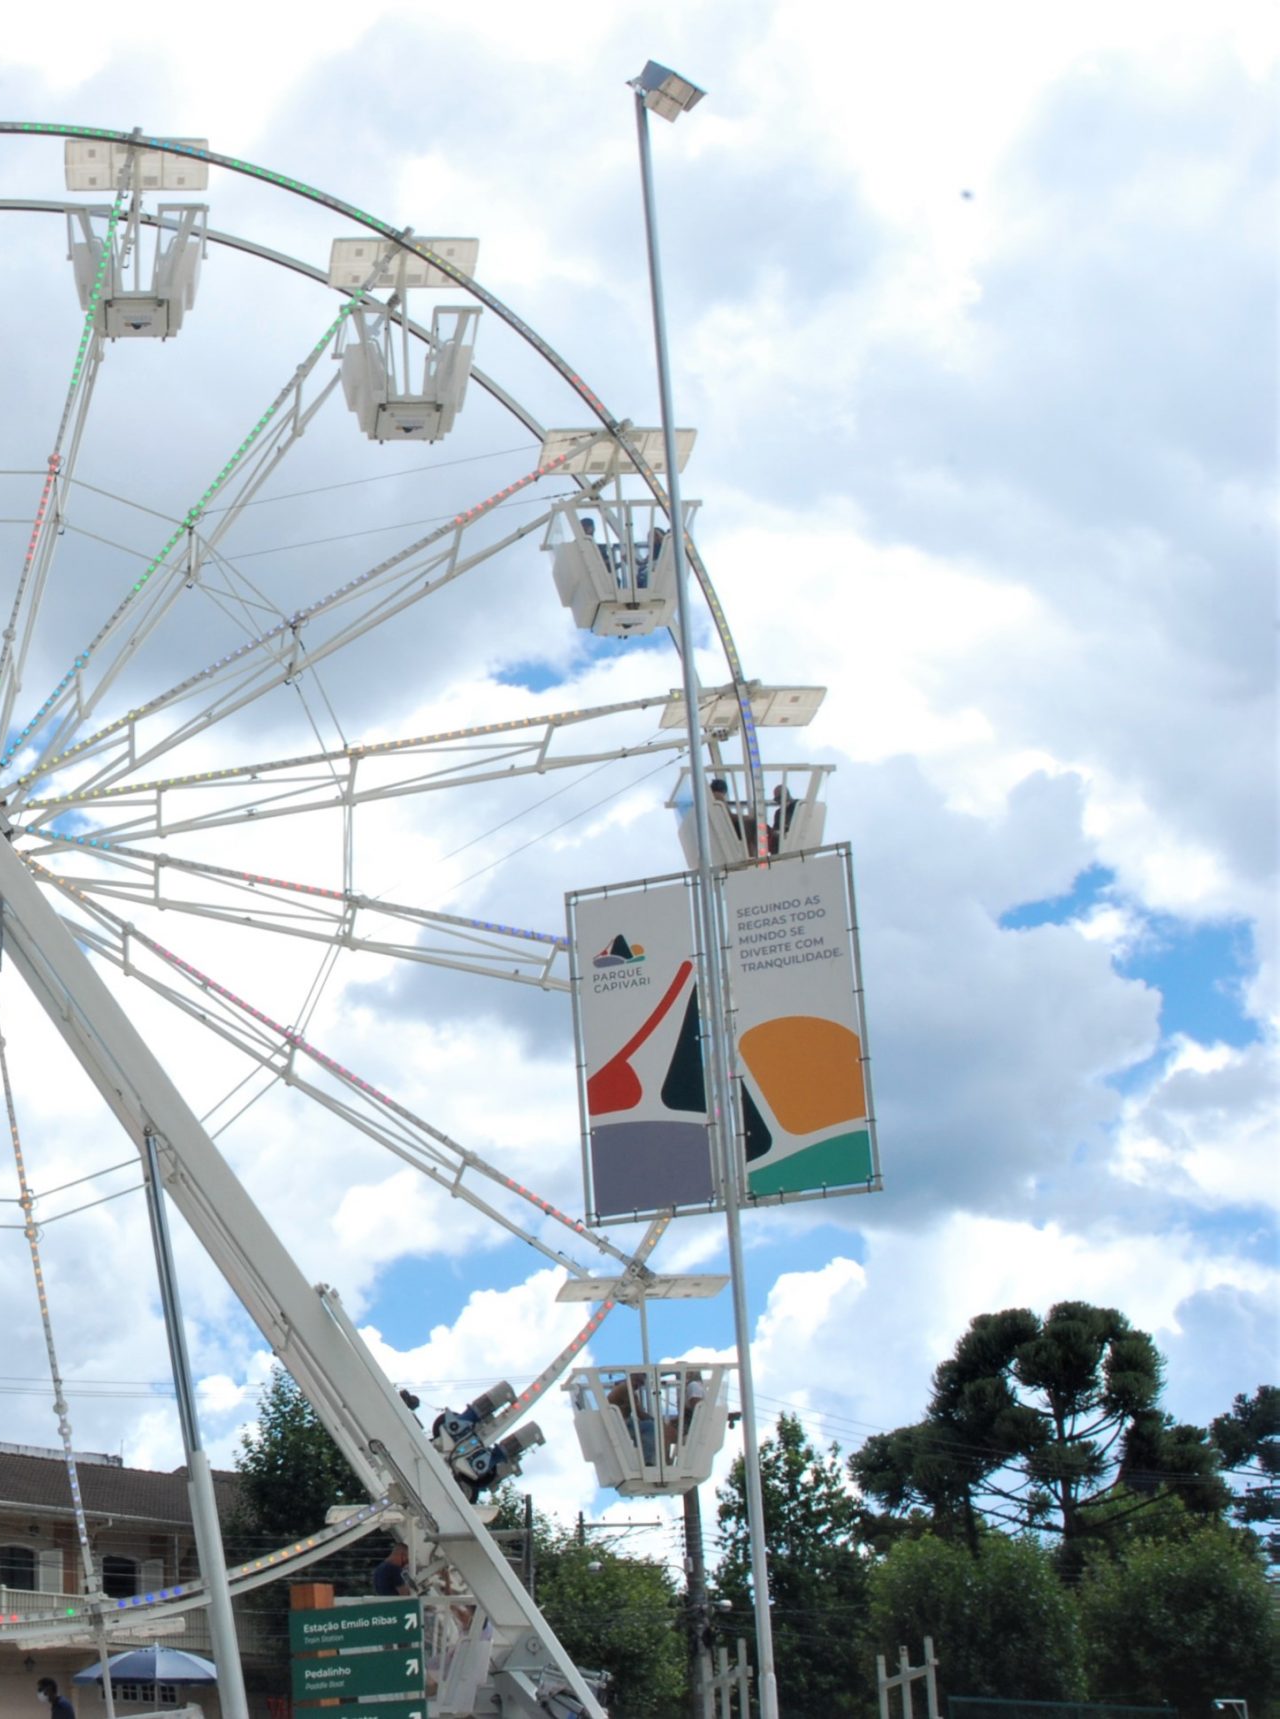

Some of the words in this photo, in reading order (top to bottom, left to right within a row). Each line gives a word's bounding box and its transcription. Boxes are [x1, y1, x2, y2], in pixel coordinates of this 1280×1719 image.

[736, 899, 801, 918] SEGUINDO
[804, 895, 821, 905] AS
[738, 914, 787, 931] REGRAS
[790, 908, 826, 922] TODO
[739, 929, 787, 945] MUNDO
[790, 926, 805, 937] SE
[740, 942, 792, 959] DIVERTE
[795, 936, 824, 949] COM
[741, 947, 844, 972] TRANQUILIDADE.
[593, 967, 642, 982] PARQUE
[594, 977, 650, 993] CAPIVARI
[303, 1622, 339, 1633] Estação
[371, 1616, 398, 1626] Ribas
[304, 1667, 351, 1679] Pedalinho
